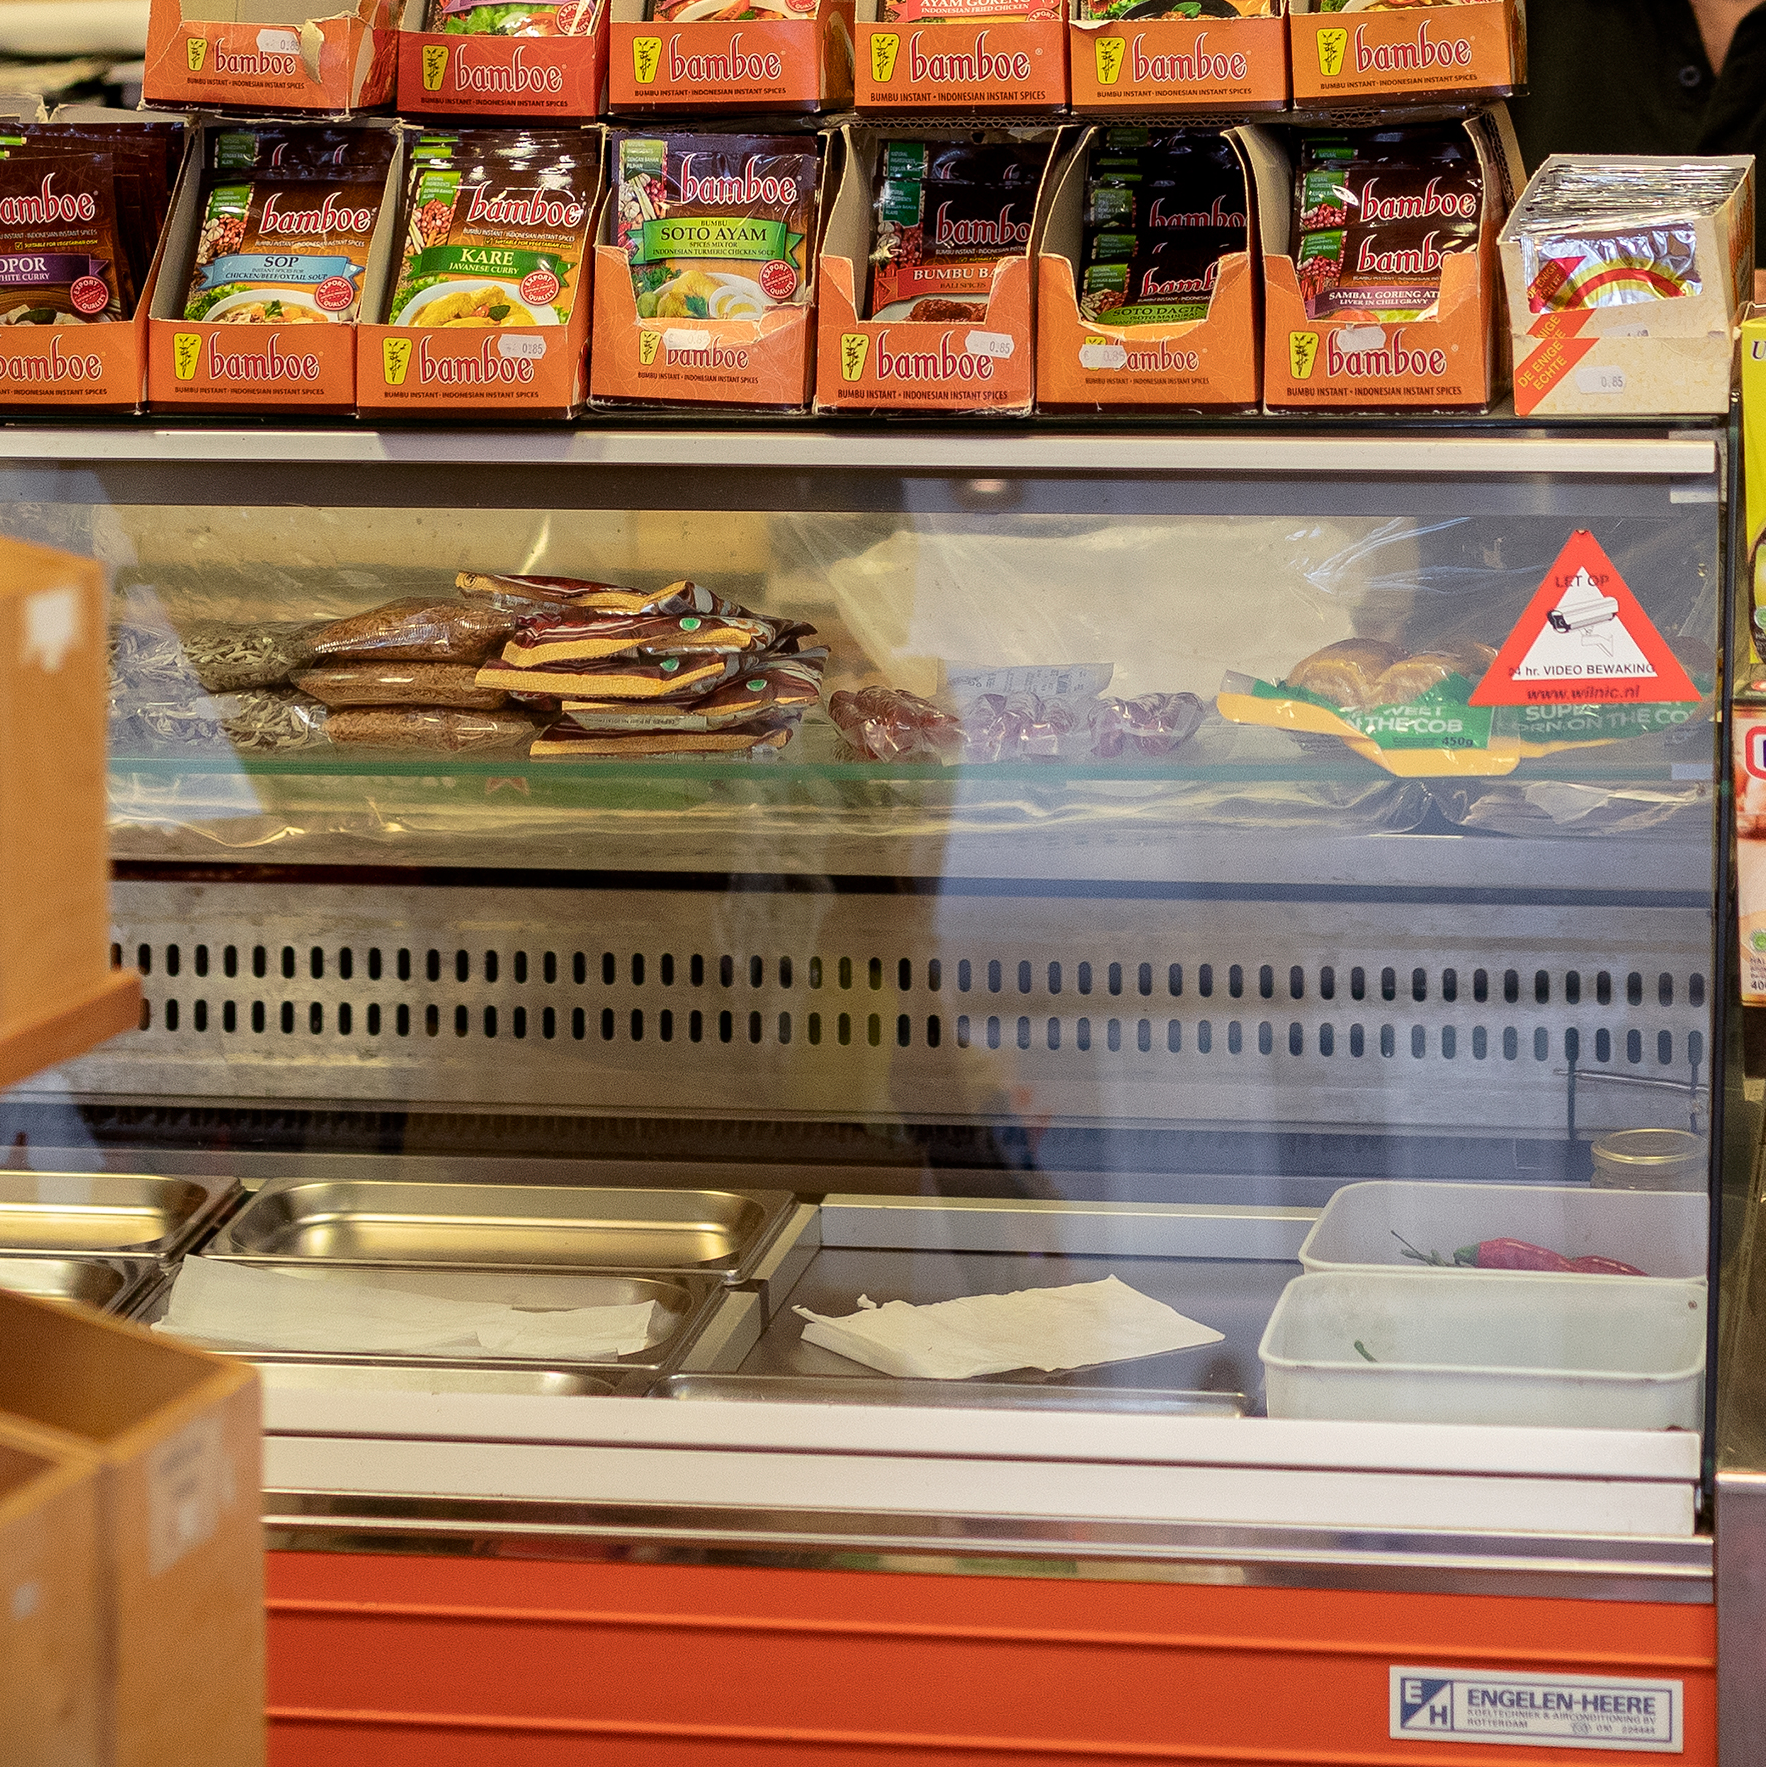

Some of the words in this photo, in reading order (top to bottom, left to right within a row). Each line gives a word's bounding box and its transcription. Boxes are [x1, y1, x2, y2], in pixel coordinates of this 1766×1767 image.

[921, 6, 967, 14] INDONESIAN
[994, 3, 1029, 11] CHICKEN
[214, 38, 296, 75] bamboe
[909, 30, 1030, 83] bamboe
[1355, 19, 1472, 73] bamboe
[669, 33, 782, 82] bamboe
[1132, 32, 1247, 82] bamboe
[454, 44, 562, 93] bamboe
[870, 92, 898, 101] BUMBU
[899, 92, 931, 101] INSTANT
[938, 92, 985, 101] INDONESIAN
[987, 92, 1019, 101] INSTANT
[1020, 91, 1046, 100] SPICES
[681, 153, 797, 205] bamboe
[467, 180, 583, 228] bamboe
[1360, 177, 1476, 223] bamboe
[259, 192, 371, 234] bamboe
[660, 227, 710, 242] SOTO
[714, 228, 767, 242] AYAM
[264, 256, 299, 268] SOP
[460, 248, 515, 266] KARE
[653, 248, 690, 256] INDONESIAN
[21, 273, 49, 281] CURRY
[449, 262, 489, 273] JAVANESE
[490, 265, 520, 275] CURRY
[913, 269, 975, 280] BUMBU
[1329, 291, 1372, 300] SAMBAL
[1375, 290, 1420, 299] GORENG
[208, 332, 320, 381] bamboe
[876, 329, 993, 382] bamboe
[989, 341, 1010, 353] 0.85
[1326, 327, 1447, 377] bamboe
[419, 334, 534, 384] bamboe
[1517, 370, 1533, 387] DE
[1532, 341, 1564, 372] ENIGE
[1533, 355, 1568, 391] ECHTE
[1601, 376, 1623, 388] 0.85
[1555, 575, 1582, 588] LET
[1587, 575, 1610, 587] OP
[1525, 665, 1540, 675] hr.
[1542, 665, 1583, 675] VIDEO
[1586, 663, 1656, 674] BEWAKING
[1527, 685, 1640, 700] www.wilnic.nl
[1414, 717, 1464, 733] COB
[1441, 735, 1475, 749] 450g
[1467, 1688, 1655, 1715] ENGELEN-HEERE
[1429, 1704, 1448, 1725] H
